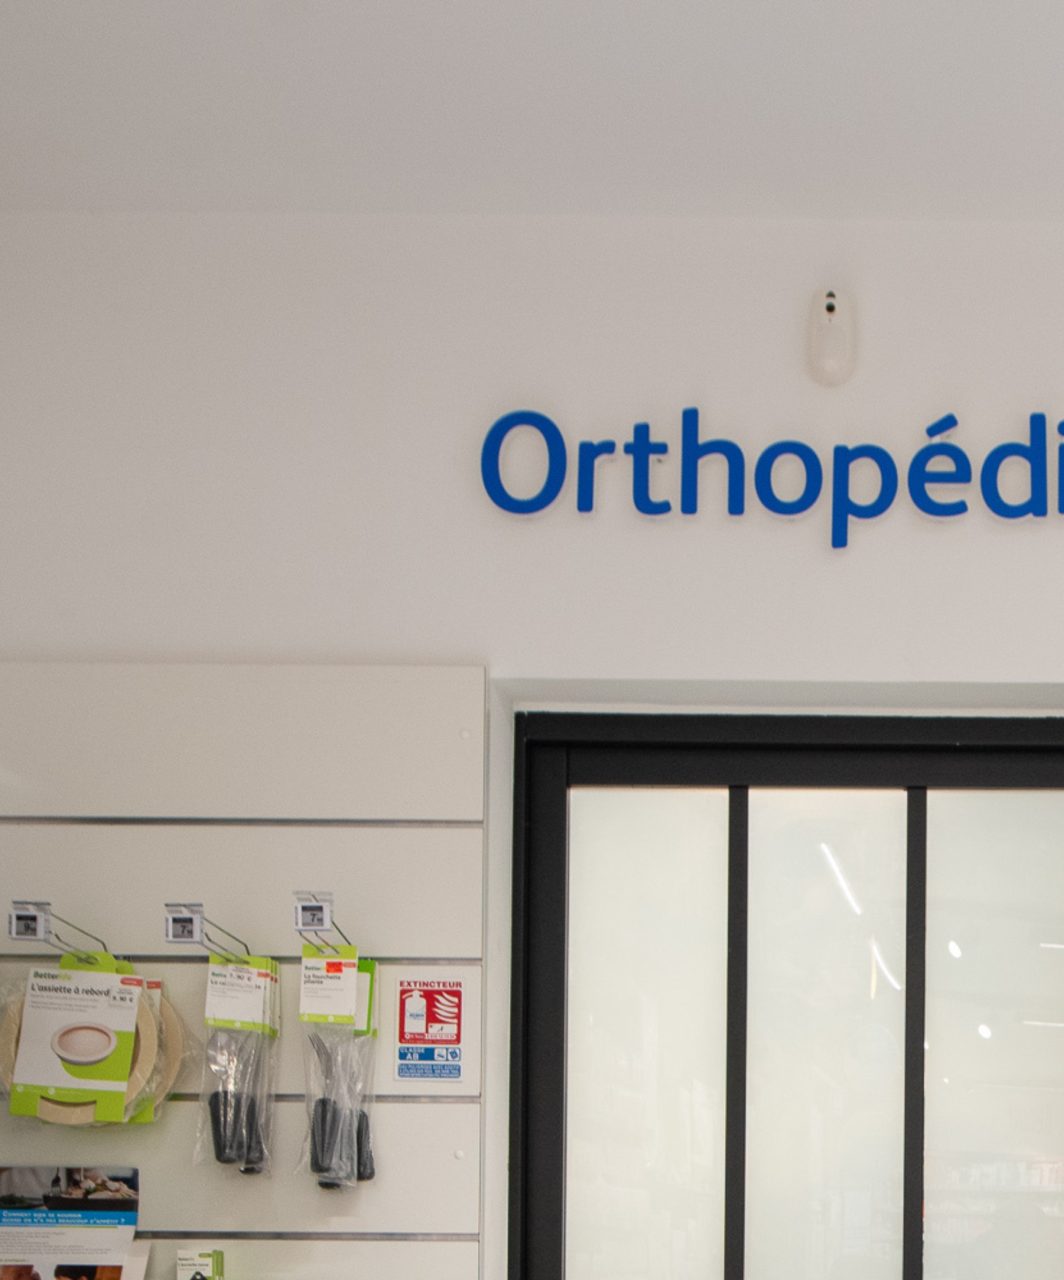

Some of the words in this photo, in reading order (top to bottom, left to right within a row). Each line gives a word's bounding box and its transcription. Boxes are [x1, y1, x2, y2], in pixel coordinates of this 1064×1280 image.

[33, 971, 71, 981] Betterlife
[400, 980, 462, 988] EXTINCTEUR
[31, 983, 71, 994] L'assiette
[74, 986, 80, 994] à
[82, 988, 110, 997] rebord
